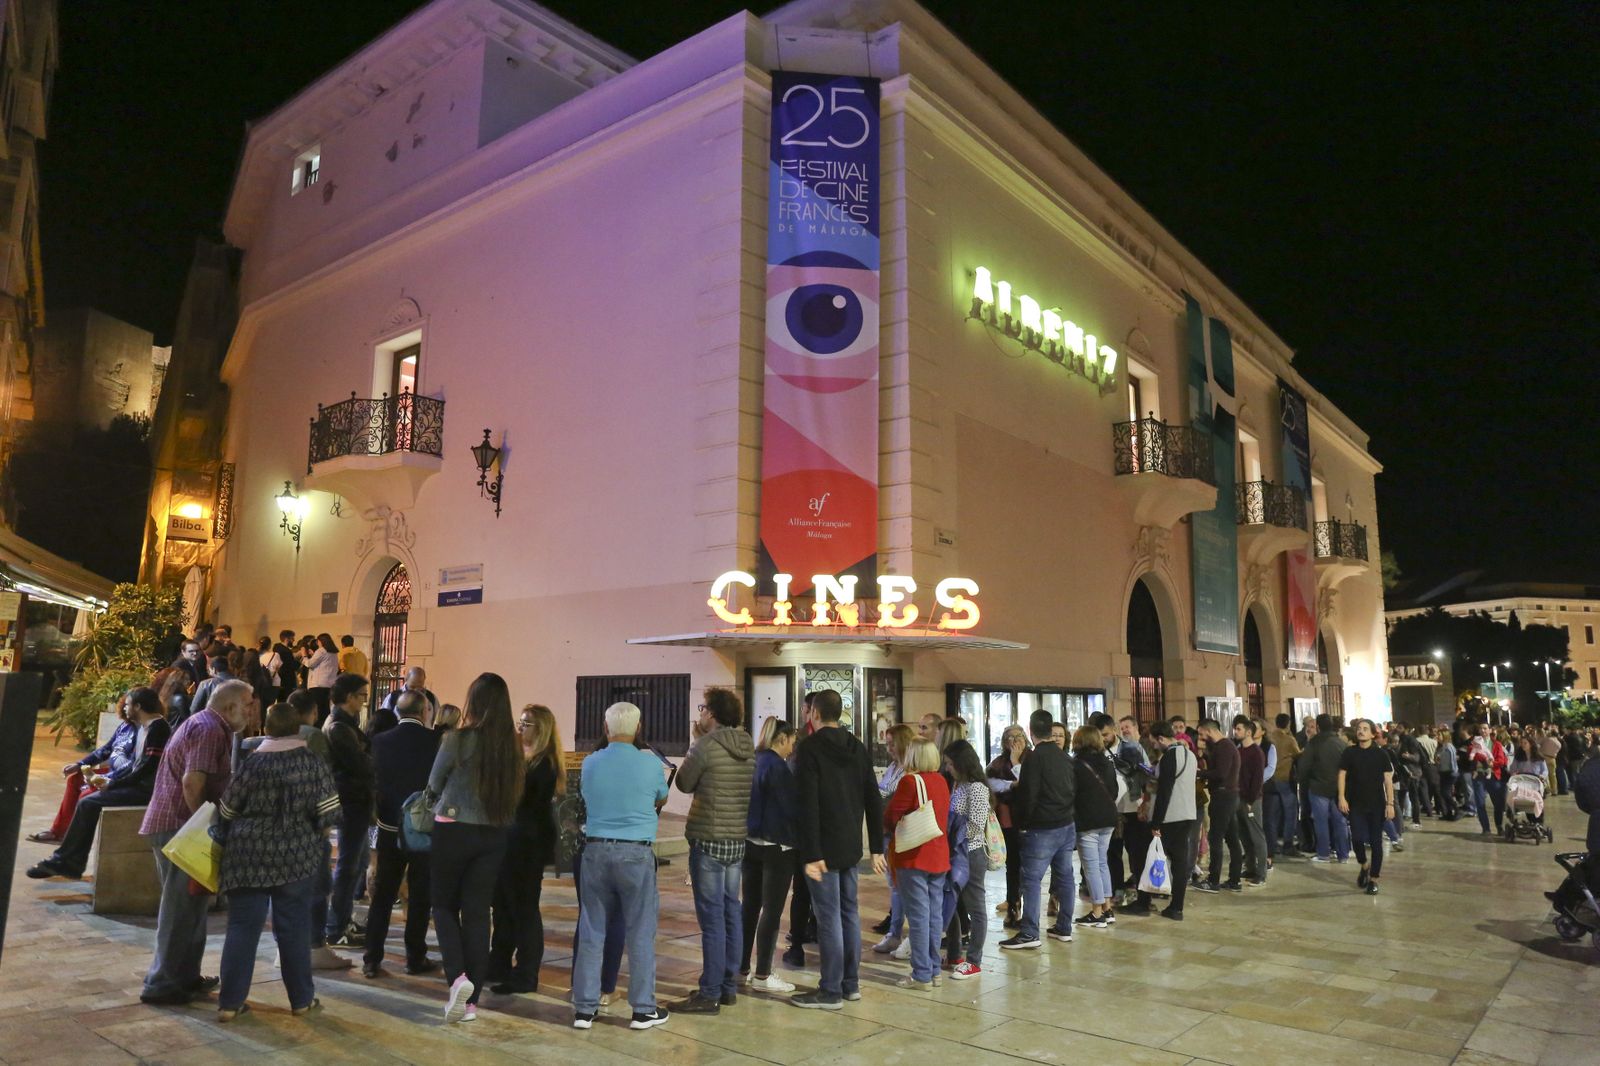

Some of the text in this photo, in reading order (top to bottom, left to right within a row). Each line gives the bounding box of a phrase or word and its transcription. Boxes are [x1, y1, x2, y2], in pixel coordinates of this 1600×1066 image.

[780, 84, 870, 149] 25
[780, 159, 868, 181] FESTIVAL
[780, 180, 868, 203] DE CINE
[778, 201, 869, 224] FRANCÉS
[778, 224, 794, 233] DE
[808, 493, 830, 516] af
[788, 518, 818, 527] Alliance
[708, 571, 980, 629] CINES
